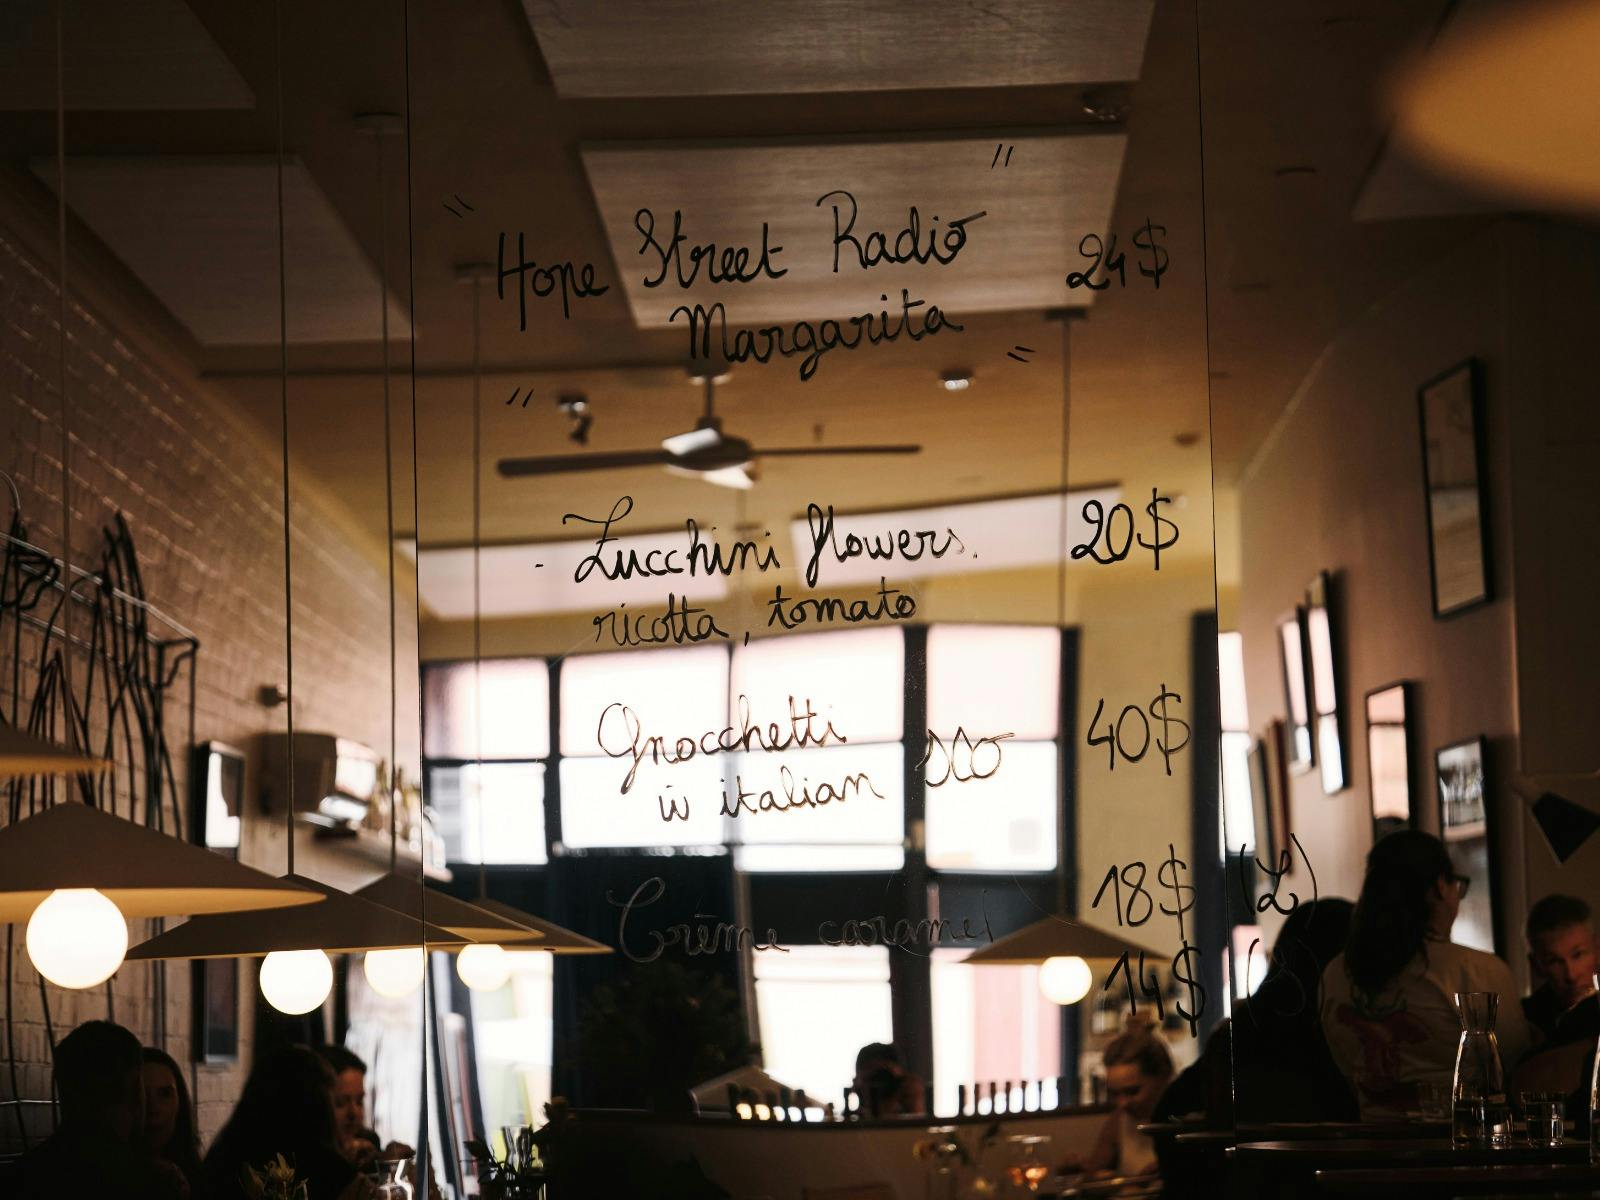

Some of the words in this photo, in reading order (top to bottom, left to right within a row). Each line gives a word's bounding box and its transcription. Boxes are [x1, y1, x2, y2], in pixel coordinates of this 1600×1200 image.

[496, 231, 610, 332] Hope
[633, 208, 788, 288] Street
[816, 190, 988, 273] Radio
[1065, 217, 1171, 290] 24$
[670, 288, 964, 382] Margarita
[562, 495, 782, 585] Zucchini
[1070, 488, 1180, 570] 20$
[767, 576, 918, 630] tomato
[597, 694, 848, 795] Gnocchetti
[1087, 683, 1192, 776] 40$
[718, 765, 886, 819] italian
[1092, 843, 1198, 940] 18$
[1103, 940, 1207, 1038] 14$
